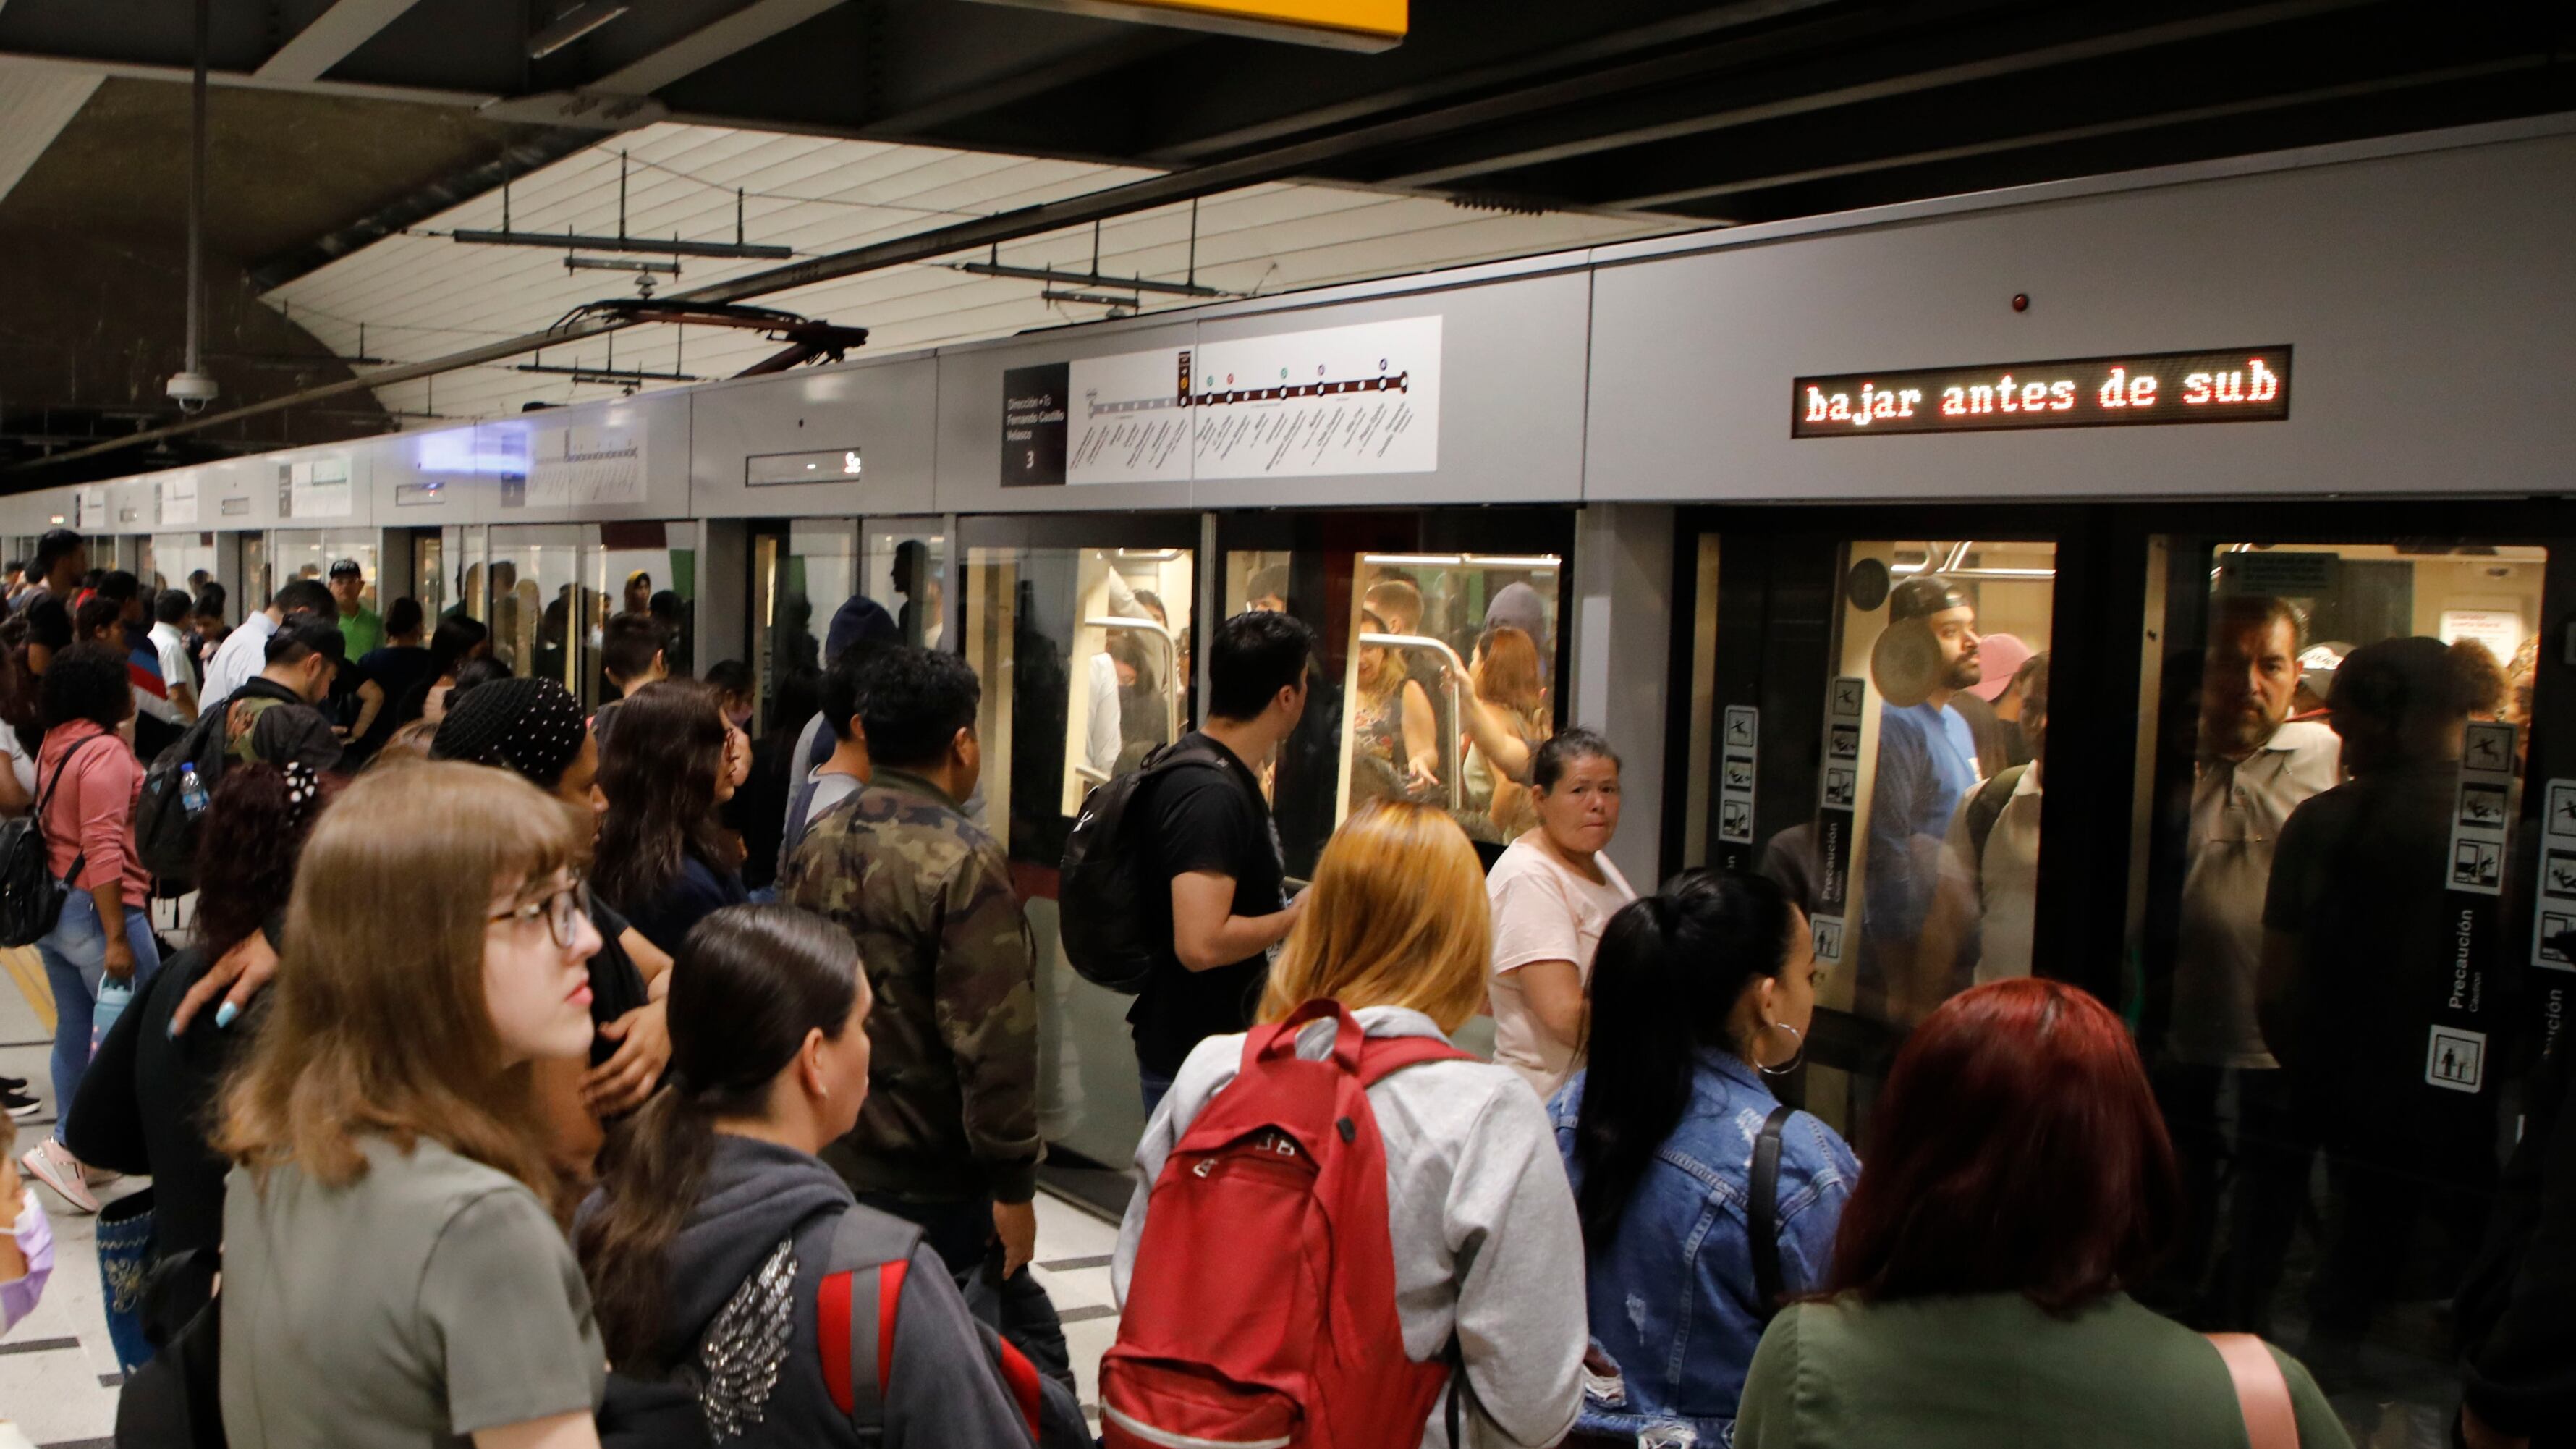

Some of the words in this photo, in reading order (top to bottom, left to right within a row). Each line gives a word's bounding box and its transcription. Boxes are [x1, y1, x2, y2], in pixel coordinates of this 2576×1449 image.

[1806, 384, 1921, 426] bajar
[1940, 374, 2075, 418] antes
[2098, 366, 2158, 408] de
[2183, 358, 2278, 405] sub
[1039, 409, 1065, 423] Castillo
[1026, 449, 1035, 469] 3
[2449, 910, 2473, 1009] Precaución
